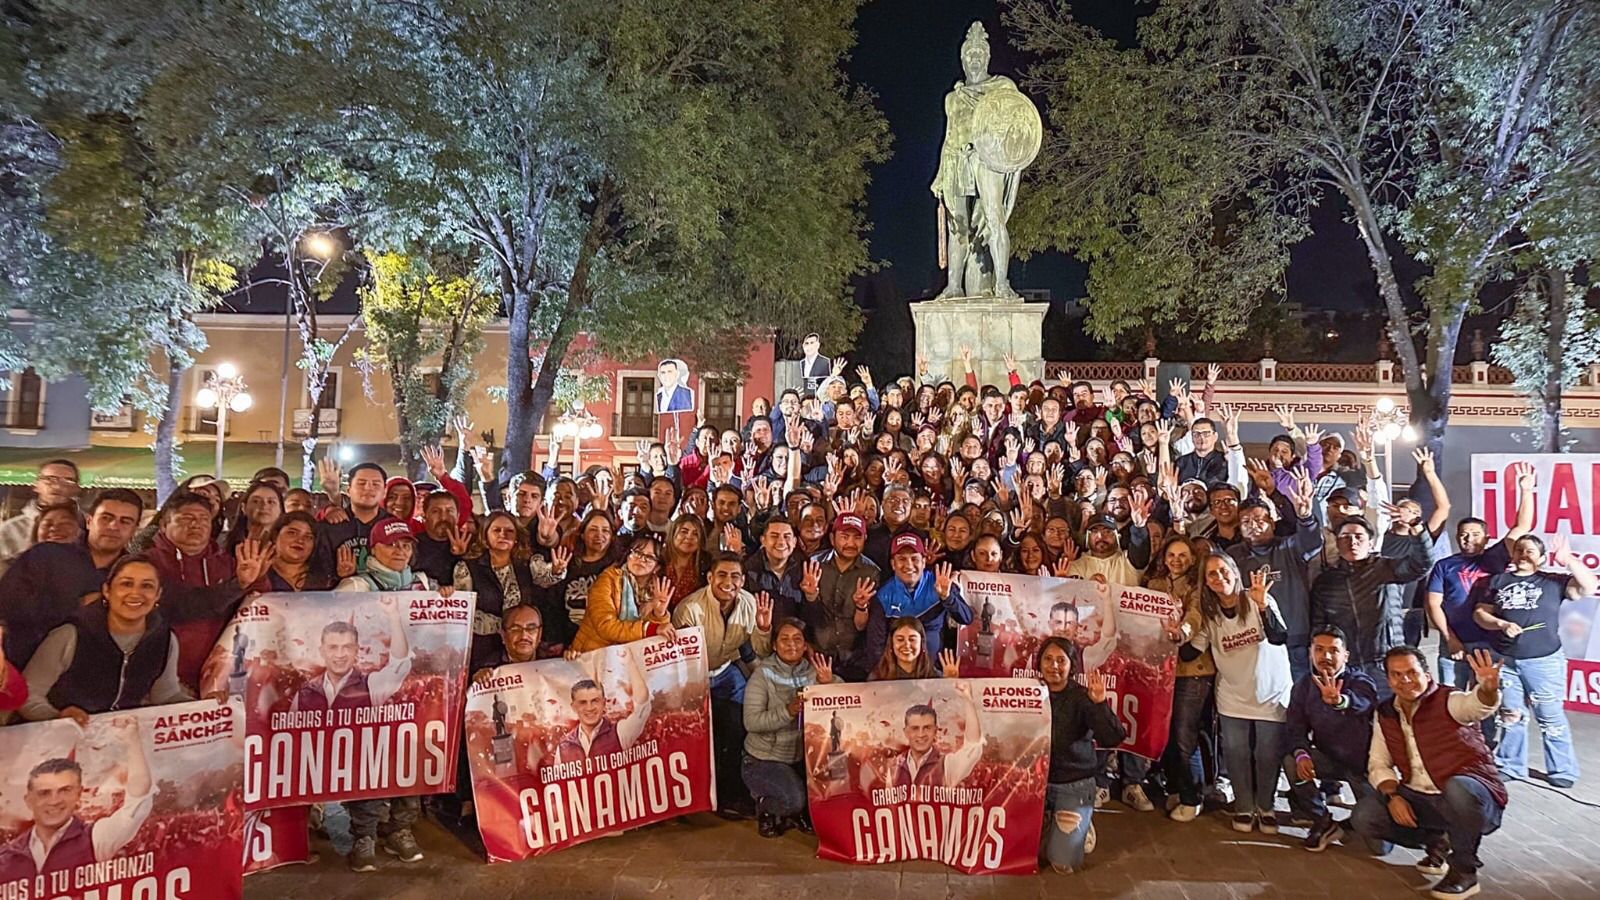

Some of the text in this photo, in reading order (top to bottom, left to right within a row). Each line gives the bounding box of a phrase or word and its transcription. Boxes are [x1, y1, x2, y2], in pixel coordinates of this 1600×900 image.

[967, 580, 1011, 593] morena
[409, 599, 468, 610] ALFONSO
[409, 609, 468, 621] SÁNCHEZ
[1119, 599, 1174, 616] SÁNCHEZ
[643, 635, 698, 656] ALFONSO
[1221, 627, 1257, 642] ALFONSO
[644, 645, 700, 667] SÁNCHEZ
[812, 694, 861, 707] morena
[983, 686, 1041, 697] ALFONSO
[983, 697, 1042, 709] SÁNCHEZ
[154, 706, 233, 729] ALFONSO
[271, 702, 415, 731] GRACIAS A TU CONFIANZA
[154, 720, 233, 745] SÁNCHEZ
[243, 719, 446, 804] GANAMOS
[540, 739, 658, 785] GRACIAS A TU CONFIANZA
[519, 751, 692, 849] GANAMOS
[872, 784, 983, 806] GRACIAS A TU CONFIANZA
[852, 804, 1006, 869] GANAMOS
[35, 875, 45, 899] A
[51, 869, 69, 895] TU
[75, 851, 154, 889] CONFIANZA
